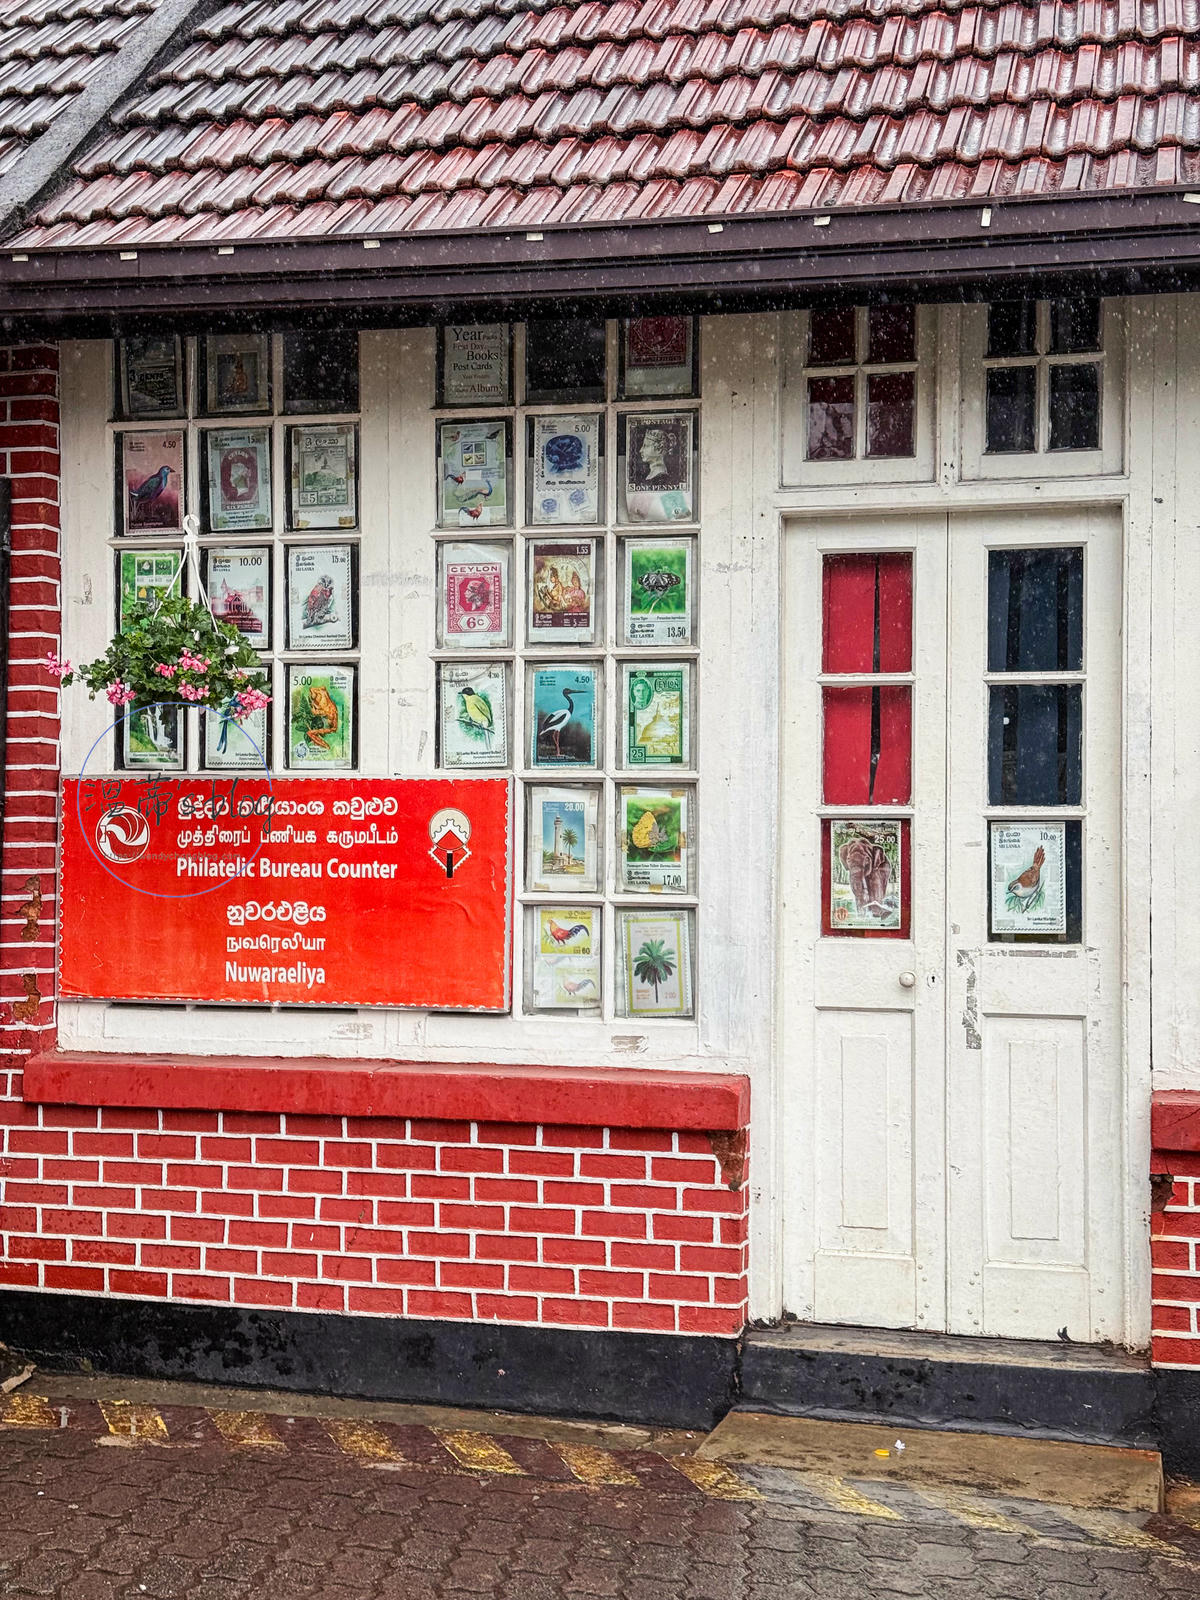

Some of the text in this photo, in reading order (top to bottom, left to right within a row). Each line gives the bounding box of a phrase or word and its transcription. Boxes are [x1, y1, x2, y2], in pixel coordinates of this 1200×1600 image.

[452, 327, 483, 341] Year
[466, 350, 499, 361] Books
[453, 362, 493, 371] Post Cards
[470, 384, 499, 393] Album
[574, 424, 591, 432] 5.00
[310, 494, 316, 503] 5
[240, 557, 262, 566] 10.00
[467, 617, 476, 628] 6
[668, 627, 685, 637] 13.50
[294, 676, 312, 685] 5.00
[654, 679, 679, 692] CEYLON
[632, 749, 643, 757] 25
[874, 835, 896, 843] 25.00
[1040, 831, 1057, 841] 10.00
[176, 858, 398, 879] Philatelic Bureau Counter
[663, 875, 682, 886] 17.00
[225, 960, 326, 989] Nuwaraeliya
